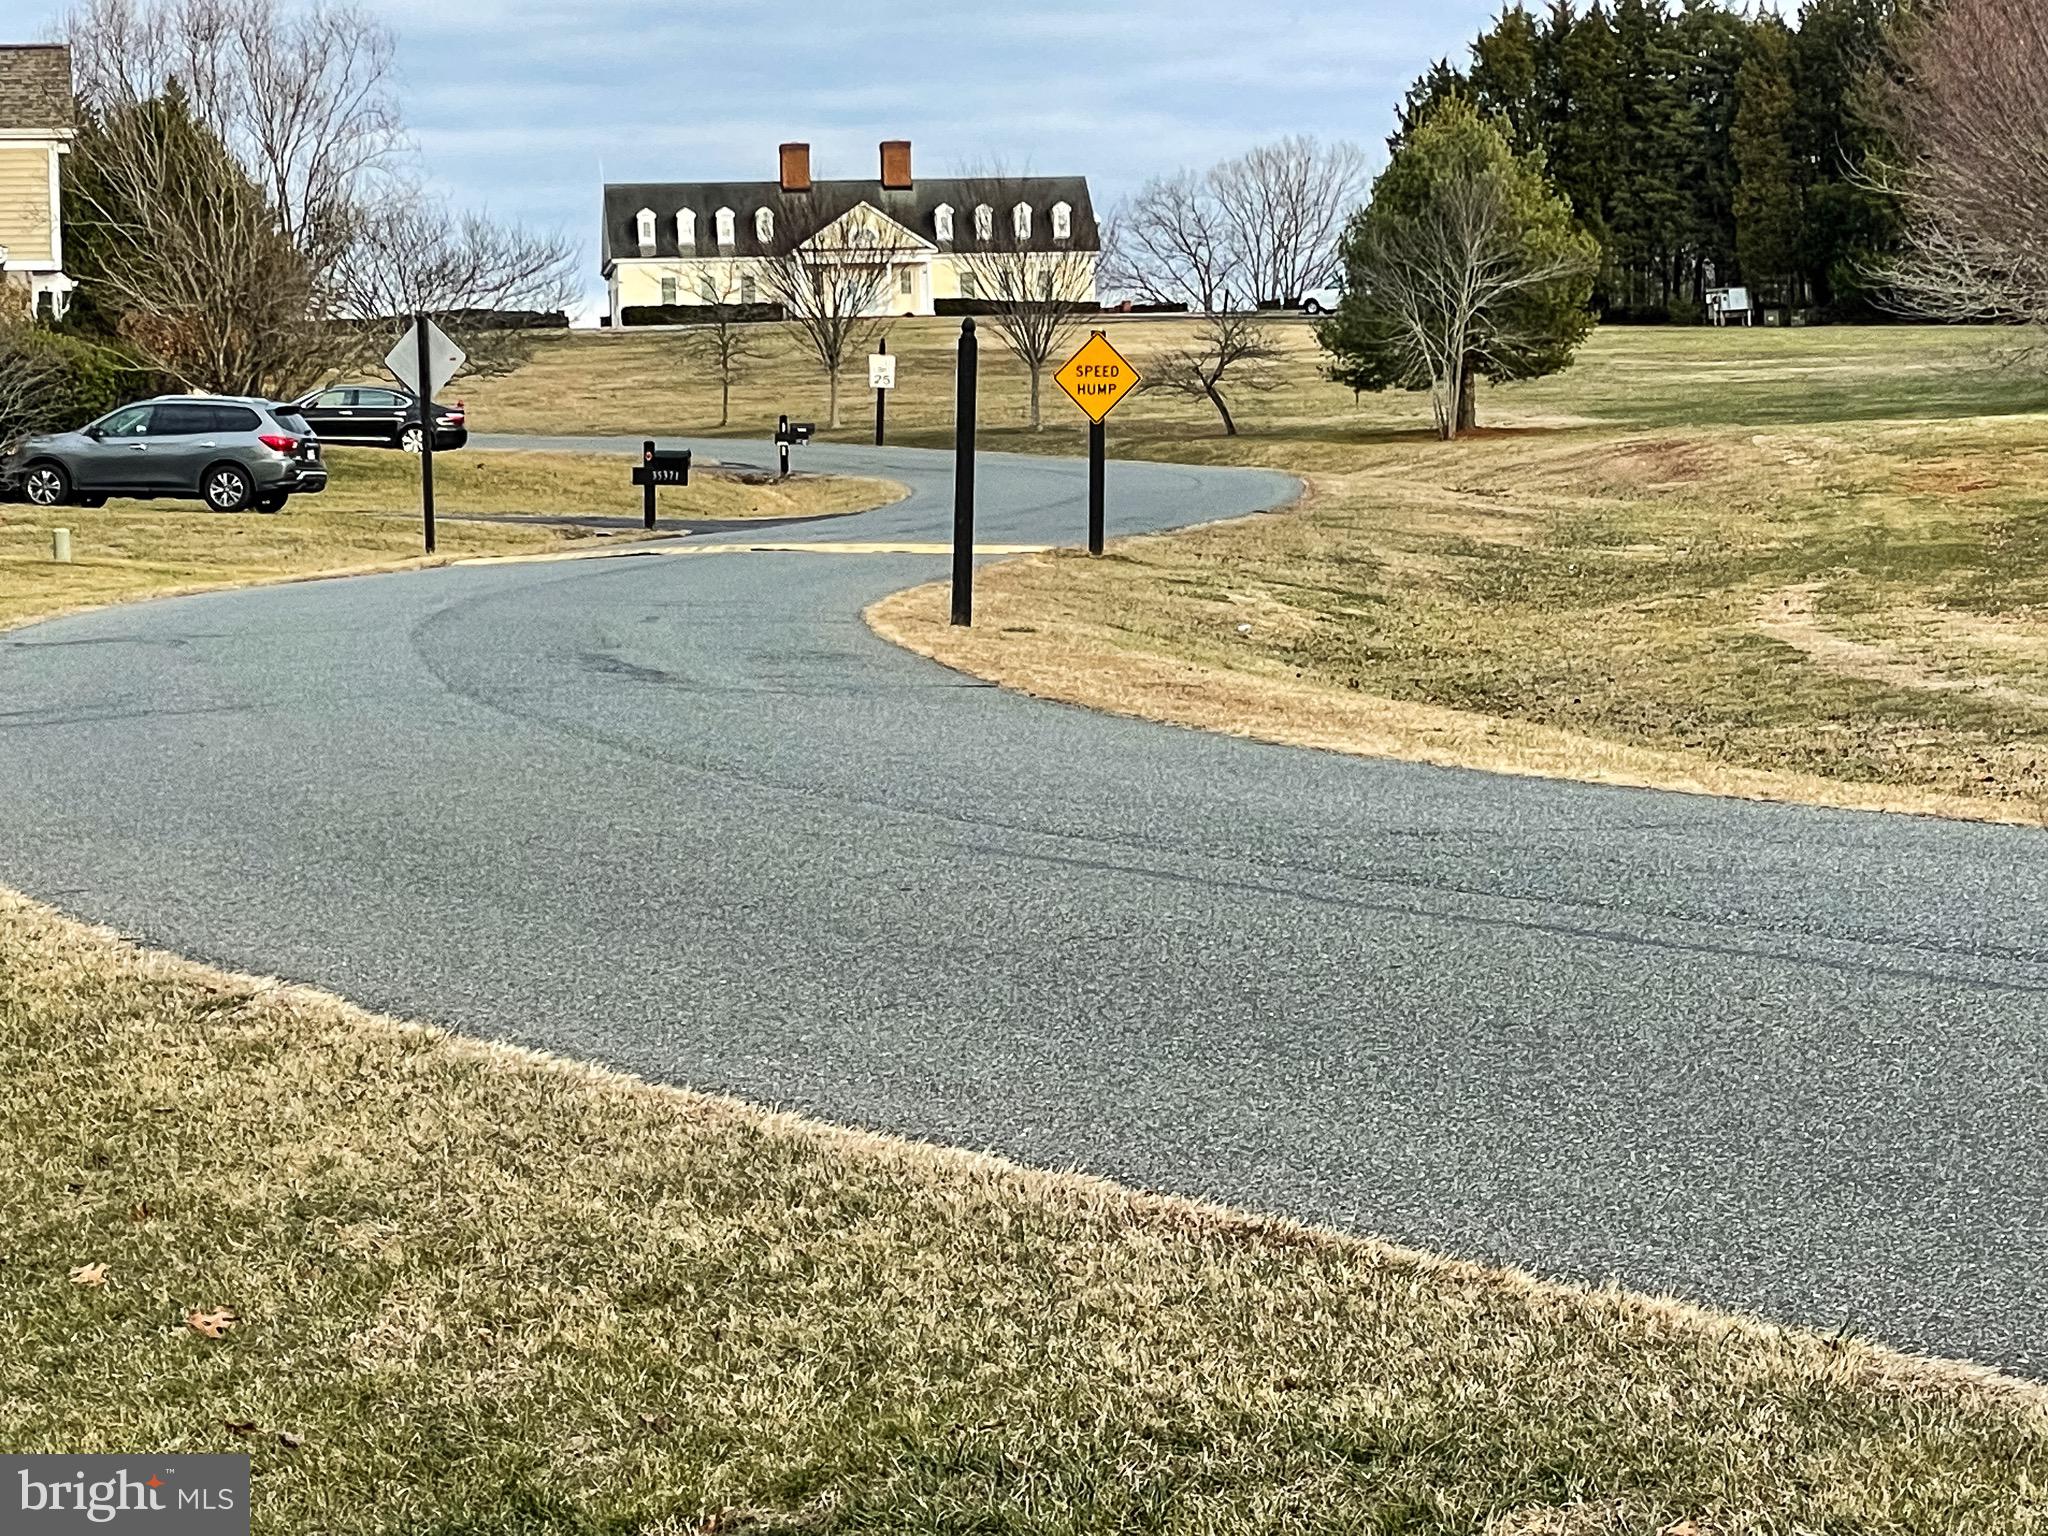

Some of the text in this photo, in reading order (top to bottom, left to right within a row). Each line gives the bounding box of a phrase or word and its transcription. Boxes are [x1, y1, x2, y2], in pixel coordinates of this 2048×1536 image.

[1075, 365, 1120, 378] SPEED
[874, 374, 891, 385] 25
[1077, 383, 1117, 396] HUMP
